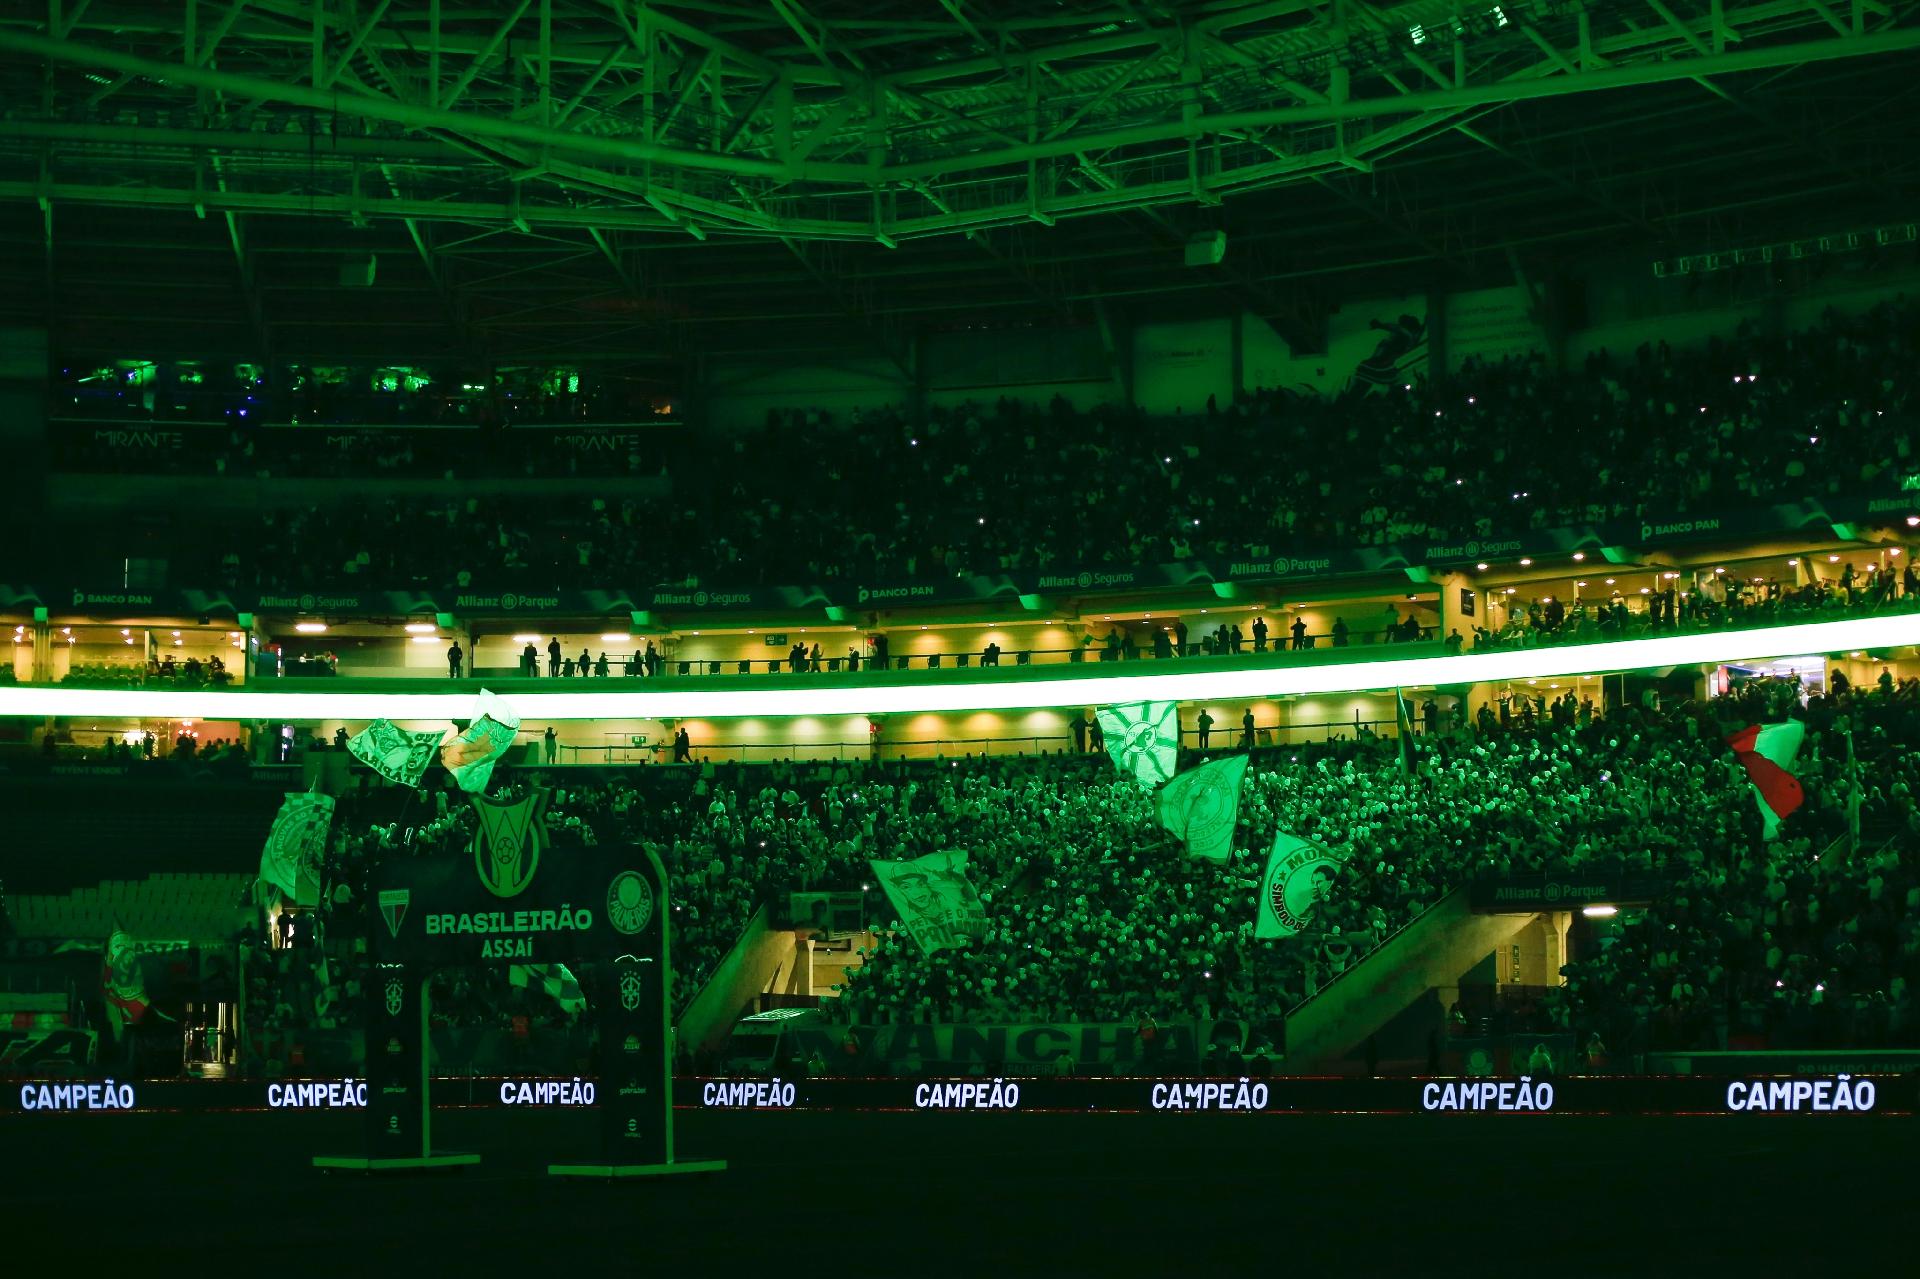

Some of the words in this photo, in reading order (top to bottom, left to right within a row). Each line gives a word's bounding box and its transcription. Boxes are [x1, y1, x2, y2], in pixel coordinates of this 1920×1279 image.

[94, 430, 183, 449] MIRANTE
[554, 434, 640, 451] MIRANTE
[1655, 522, 1693, 535] BANCO
[1695, 519, 1720, 531] PAN
[1426, 547, 1464, 559] Allianz
[1481, 540, 1522, 555] Seguros
[1230, 563, 1271, 576] Allianz
[1290, 558, 1330, 573] Parque
[1038, 576, 1076, 588] Allianz
[1094, 572, 1134, 587] Seguros
[87, 594, 125, 604] BANCO
[127, 594, 152, 604] PAN
[456, 595, 499, 607] Allianz
[518, 595, 559, 609] Parque
[653, 593, 691, 605] Allianz
[710, 592, 751, 607] Seguros
[871, 588, 908, 599] BANCO
[910, 586, 934, 596] PAN
[258, 596, 298, 608] Allianz
[316, 596, 359, 610] Seguros
[1495, 886, 1541, 901] Allianz
[1562, 884, 1607, 901] Parque
[425, 903, 592, 934] BRASILEIRÃO
[609, 898, 651, 931] PALMEIRAS
[481, 936, 534, 959] ASSAÍ
[20, 1079, 134, 1110] CAMPEÃO
[500, 1076, 595, 1105] CAMPEÃO
[703, 1077, 795, 1107] CAMPEÃO
[915, 1077, 1019, 1109] CAMPEÃO
[1151, 1077, 1268, 1111] CAMPEÃO
[1423, 1075, 1554, 1111] CAMPEÃO
[1727, 1074, 1876, 1112] CAMPEÃO
